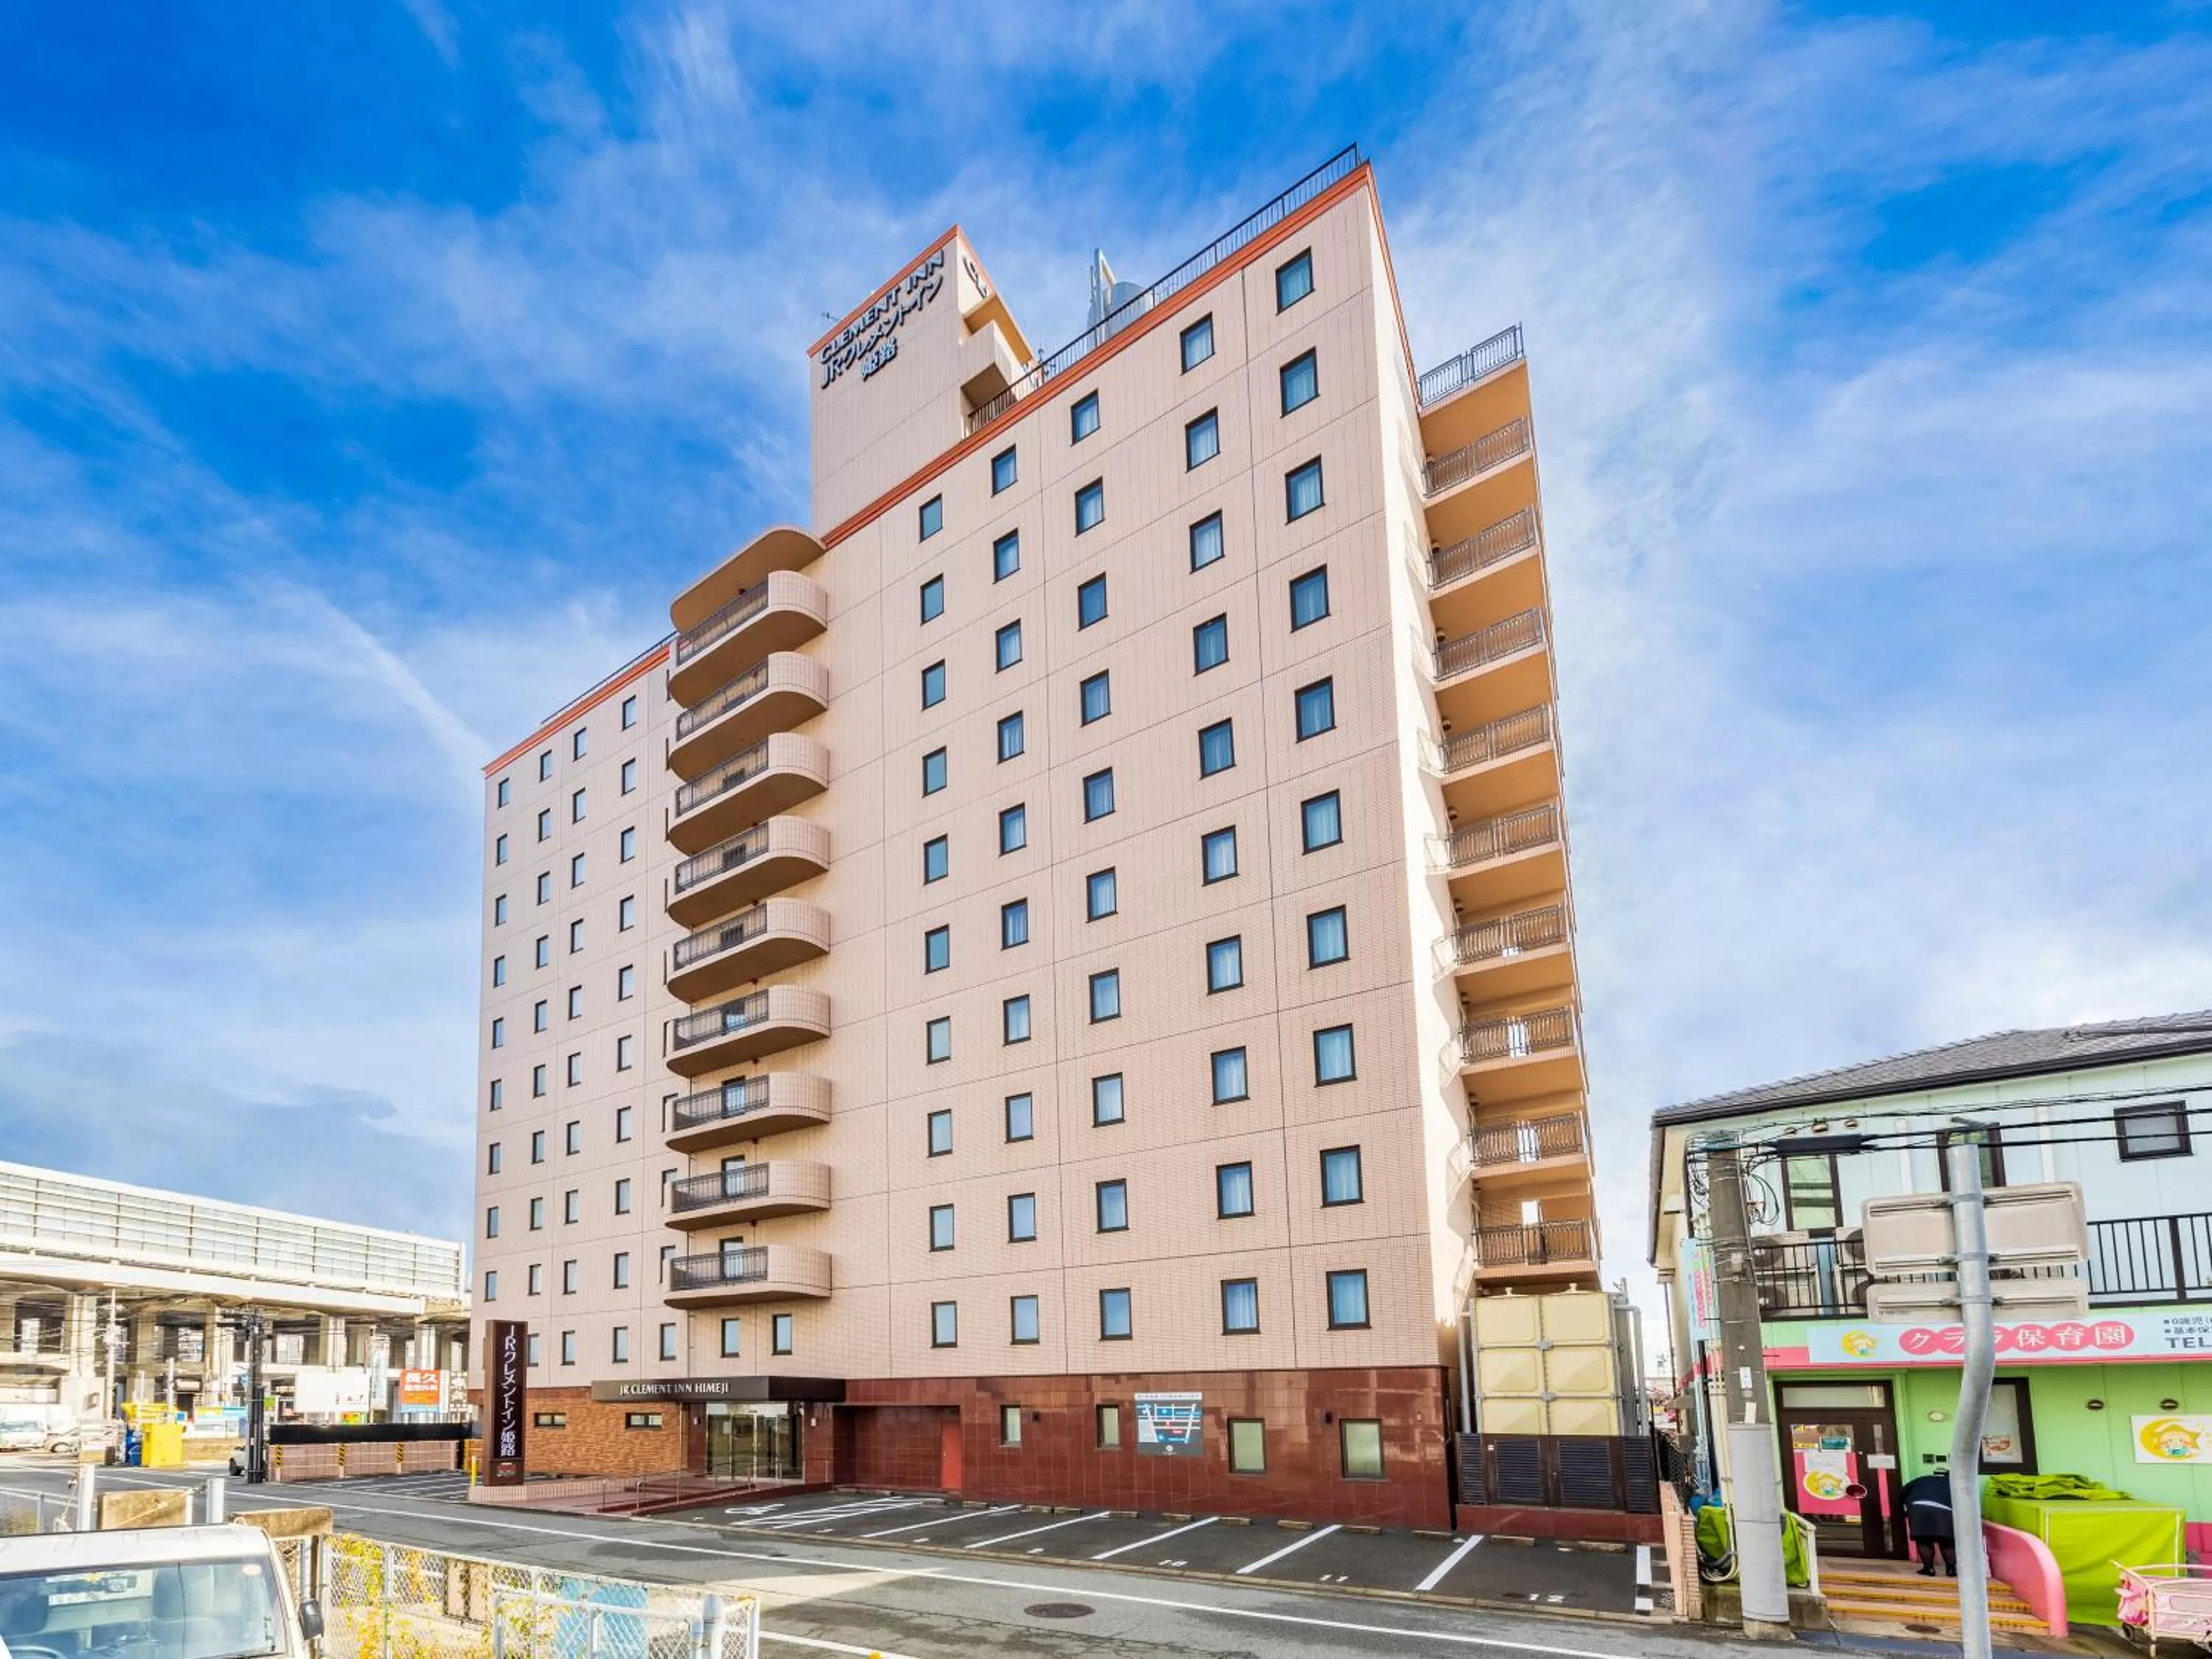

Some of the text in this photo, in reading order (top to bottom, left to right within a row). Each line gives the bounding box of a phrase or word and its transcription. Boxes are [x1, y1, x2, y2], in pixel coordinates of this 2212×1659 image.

[820, 285, 901, 364] CLEMENT
[905, 248, 945, 295] INN
[821, 274, 945, 390] JRクレメントイン
[500, 1325, 516, 1457] JRクレメントイン姫路
[620, 1382, 728, 1396] JR CLEMENT INN HIMEJI
[2164, 1336, 2212, 1349] TEL
